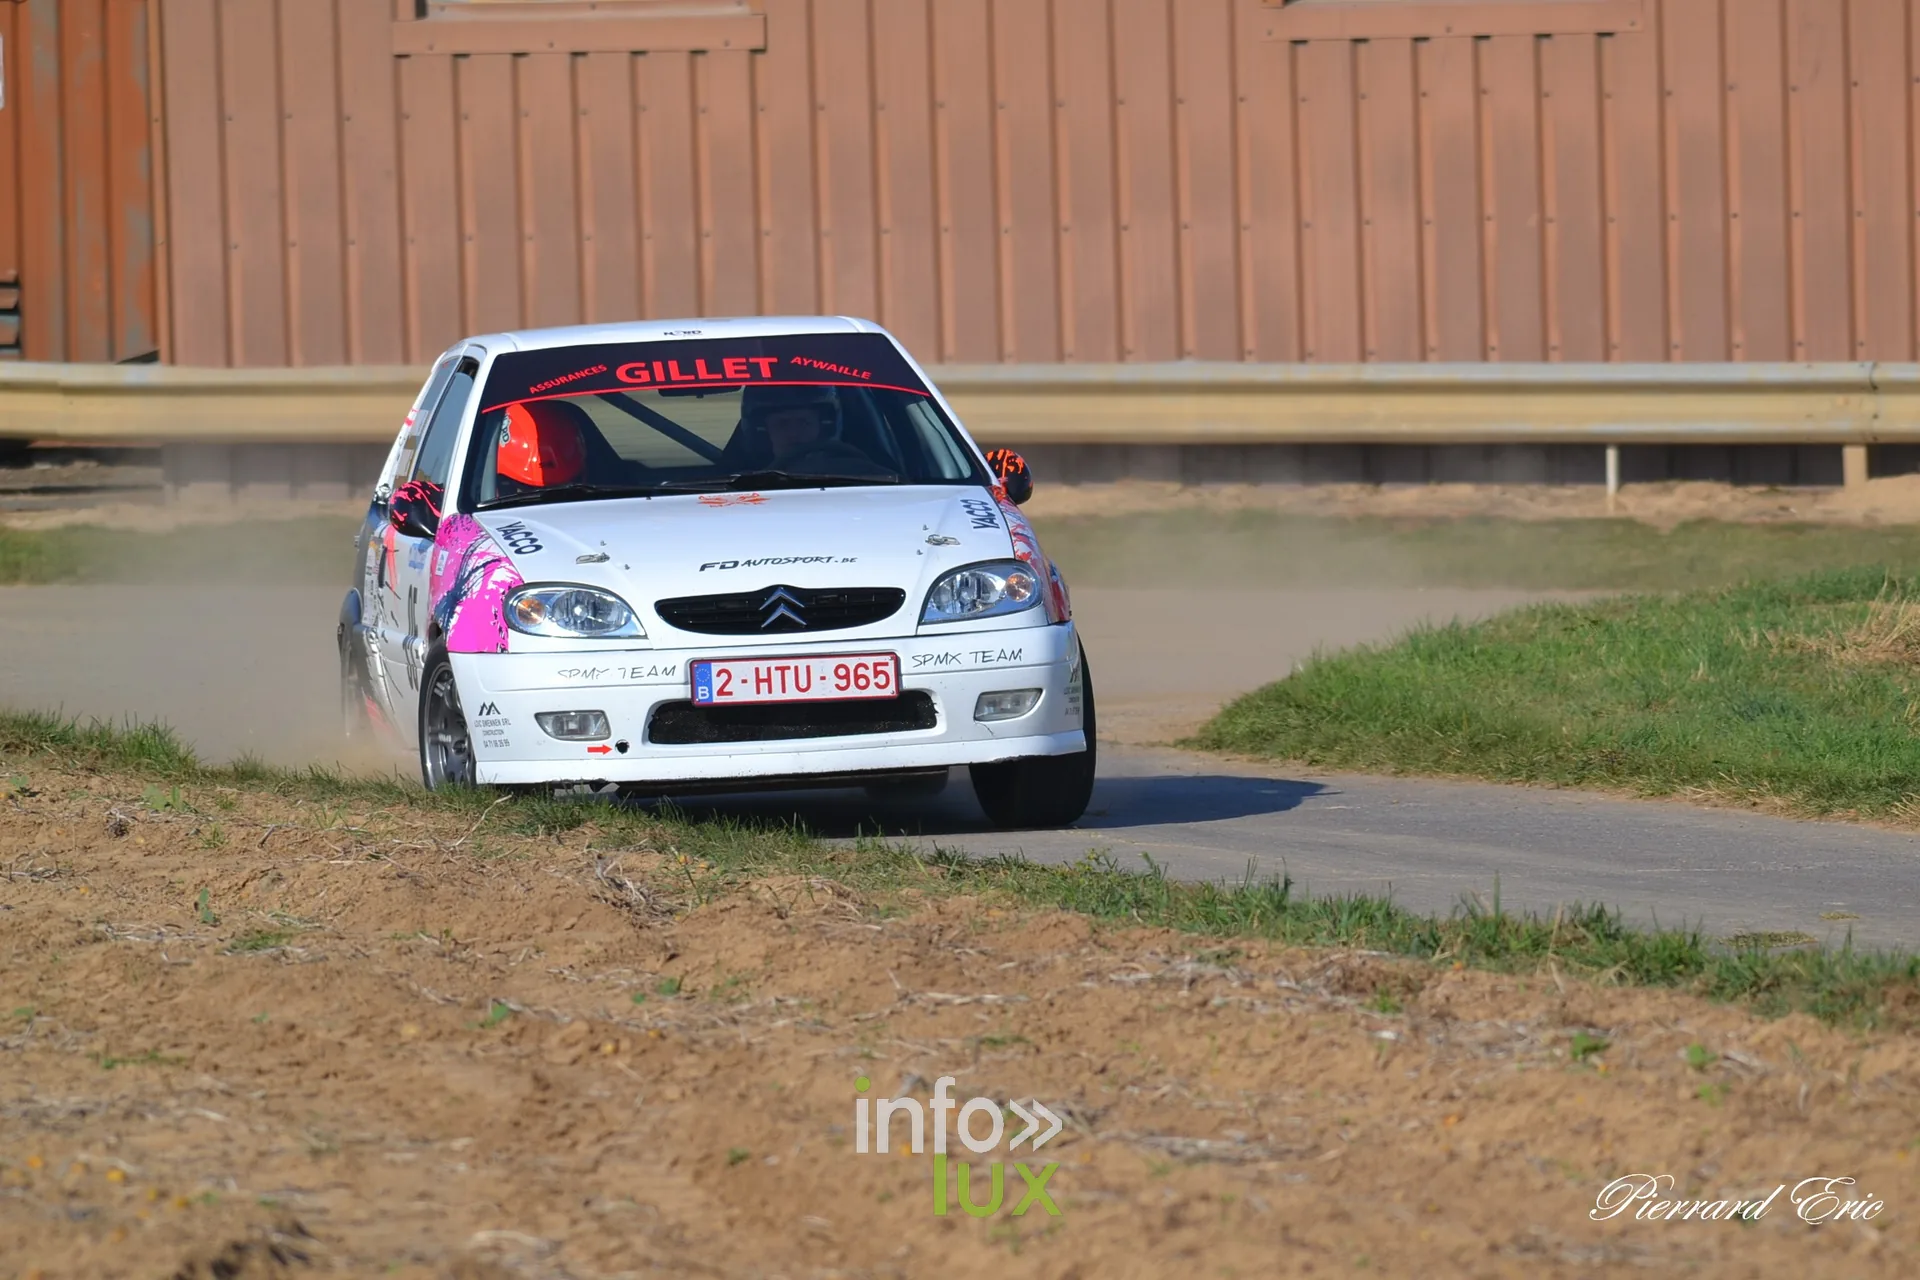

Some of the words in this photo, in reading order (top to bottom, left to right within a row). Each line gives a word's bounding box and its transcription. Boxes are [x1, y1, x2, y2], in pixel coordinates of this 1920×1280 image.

[529, 364, 607, 394] ASSURANCES
[616, 358, 778, 383] GILLET
[790, 356, 872, 380] AYWAILLE
[960, 499, 1000, 529] YACCO
[495, 520, 544, 554] YACCO
[617, 664, 677, 680] TEAM
[911, 652, 962, 668] SPMX
[969, 648, 1023, 664] TEAM
[697, 686, 709, 700] B
[715, 661, 891, 697] 2-HTU-965
